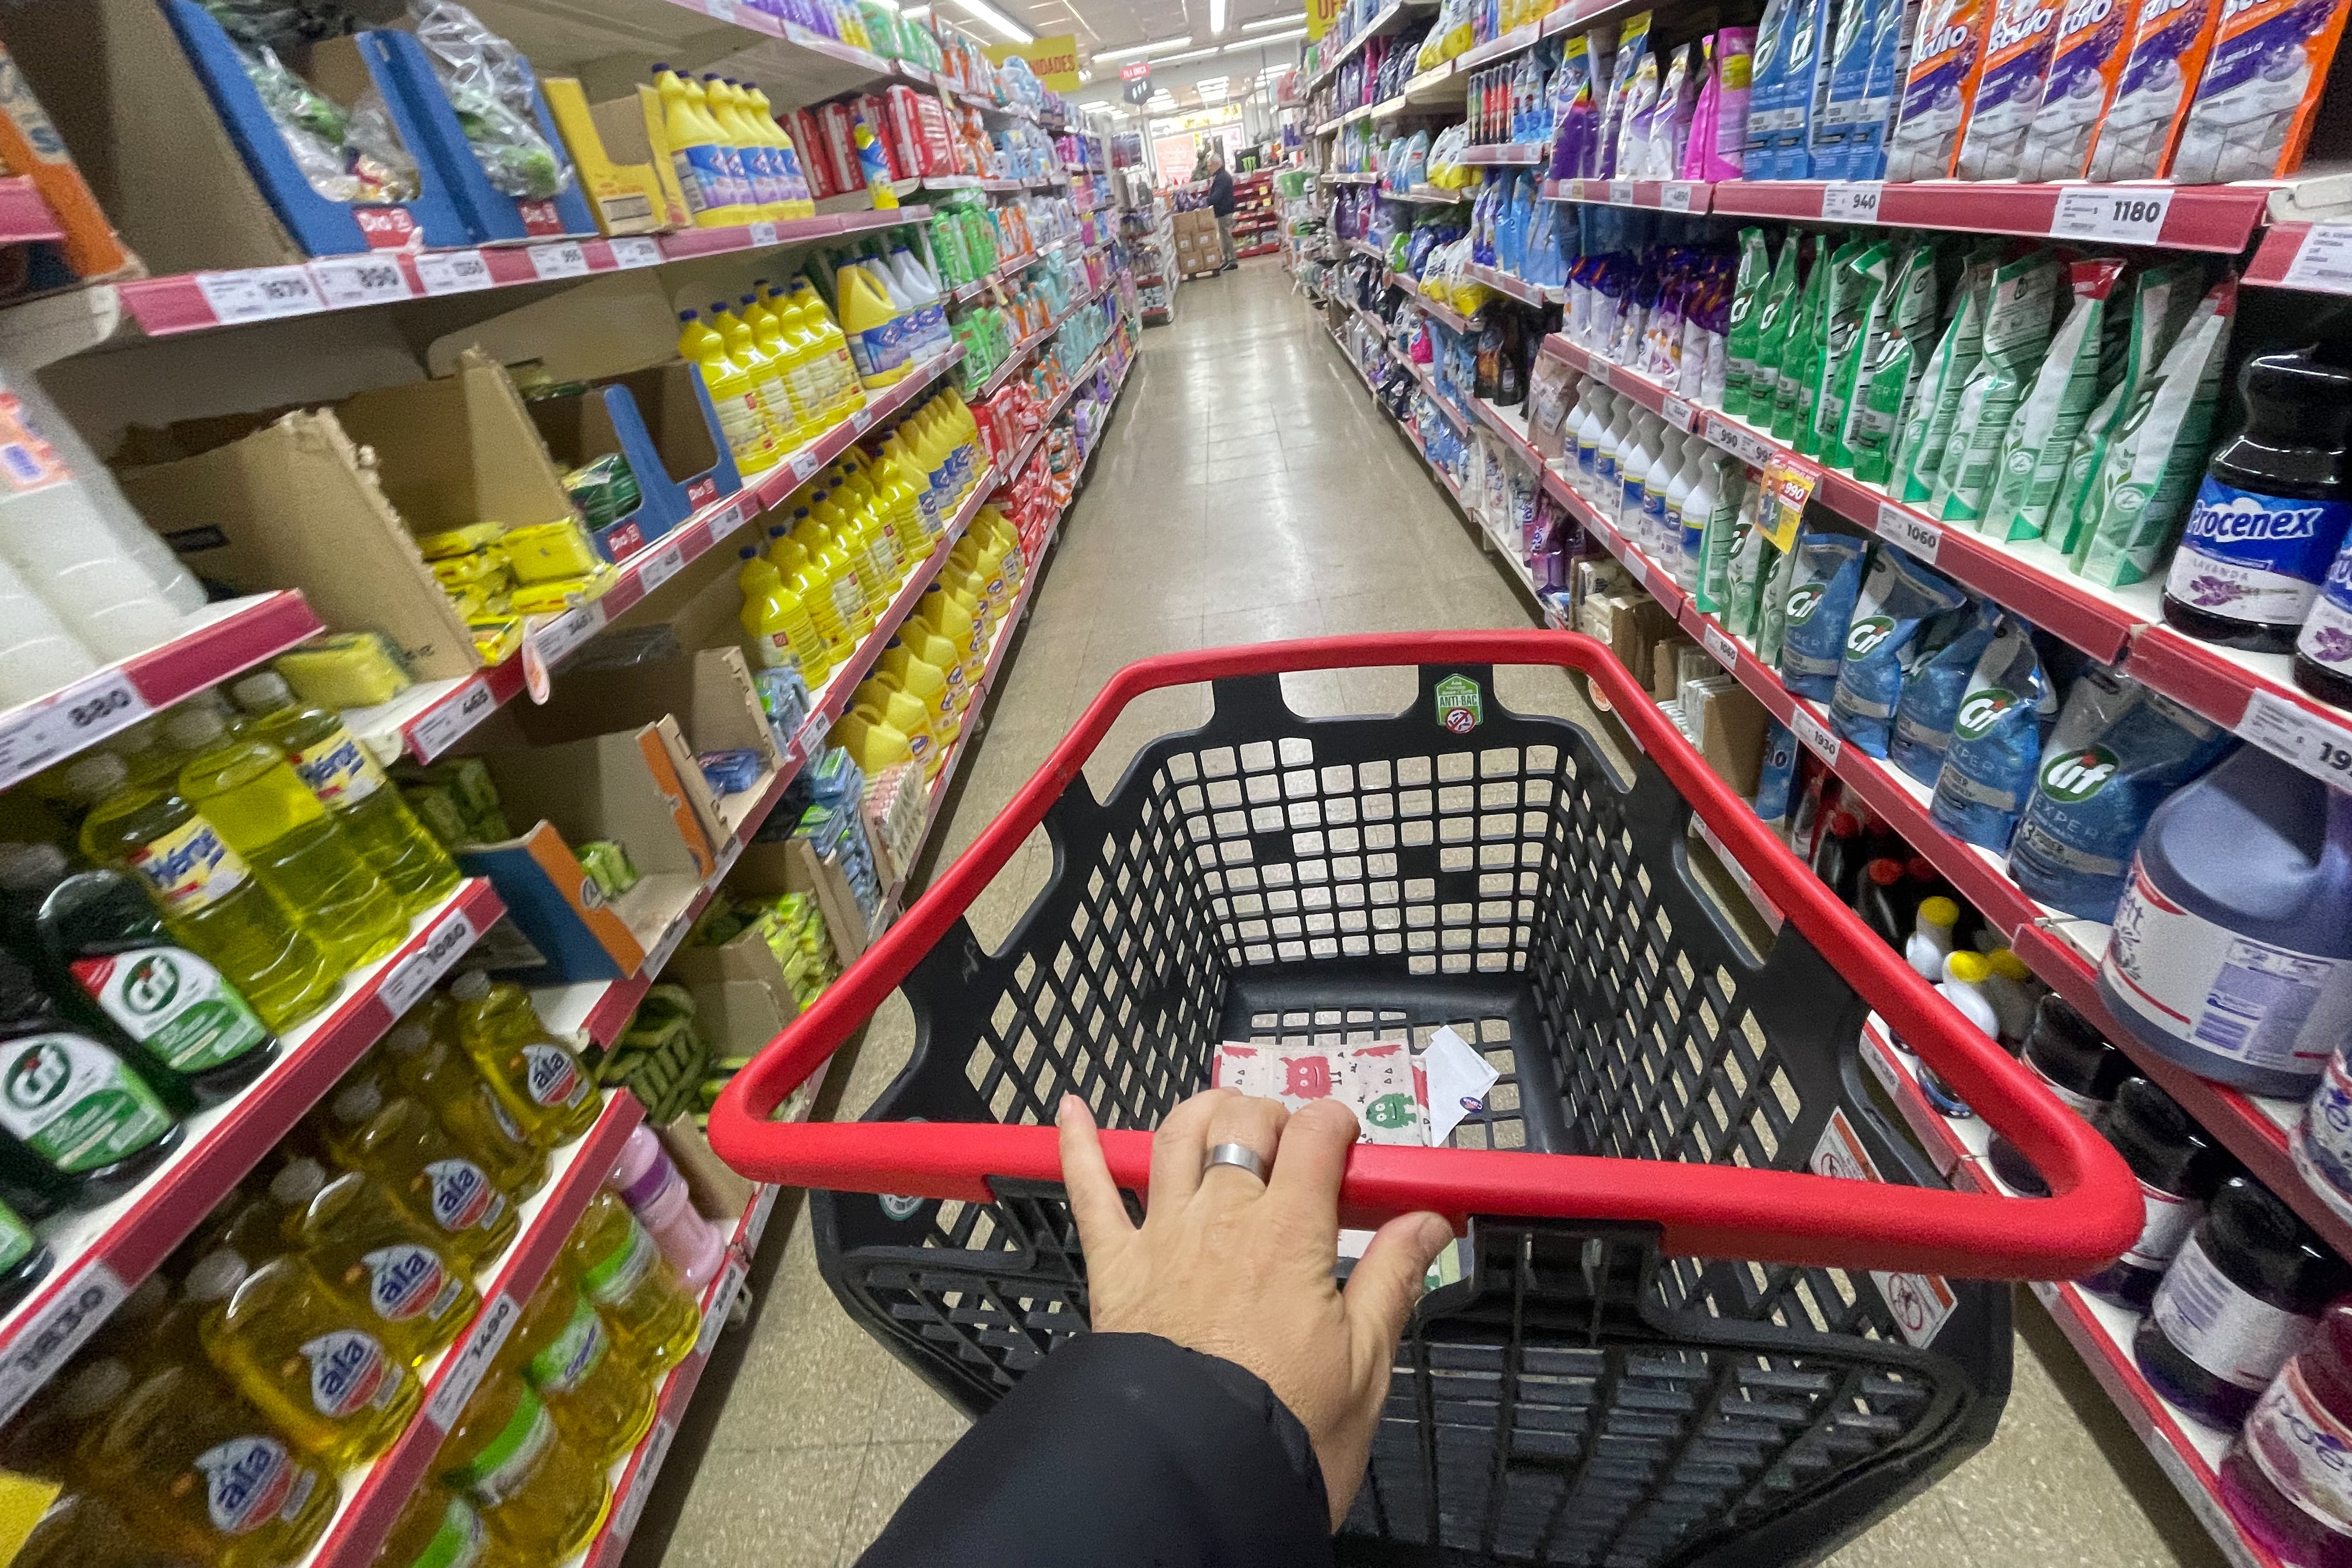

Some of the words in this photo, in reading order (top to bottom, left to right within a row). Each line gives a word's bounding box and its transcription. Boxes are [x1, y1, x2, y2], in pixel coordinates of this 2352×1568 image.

[1853, 194, 1876, 210] 940
[2113, 201, 2160, 223] 1180
[1720, 428, 1738, 447] 990
[1783, 481, 1805, 501] 990
[1907, 523, 1937, 548] 1060
[1786, 590, 1823, 618] Cif
[1720, 641, 1736, 660] 1060
[1847, 623, 1892, 654] Cif
[1959, 698, 2013, 732] Cif
[1814, 730, 1836, 755] 1930
[2047, 751, 2116, 794] Cif
[2318, 743, 2352, 775] 19
[129, 957, 177, 1012] Cif
[12, 1046, 67, 1102] Cif
[533, 1051, 566, 1089] ala
[438, 1167, 475, 1212] ala
[380, 1251, 426, 1304] ala
[319, 1340, 365, 1396] ala
[216, 1444, 272, 1510] ala
